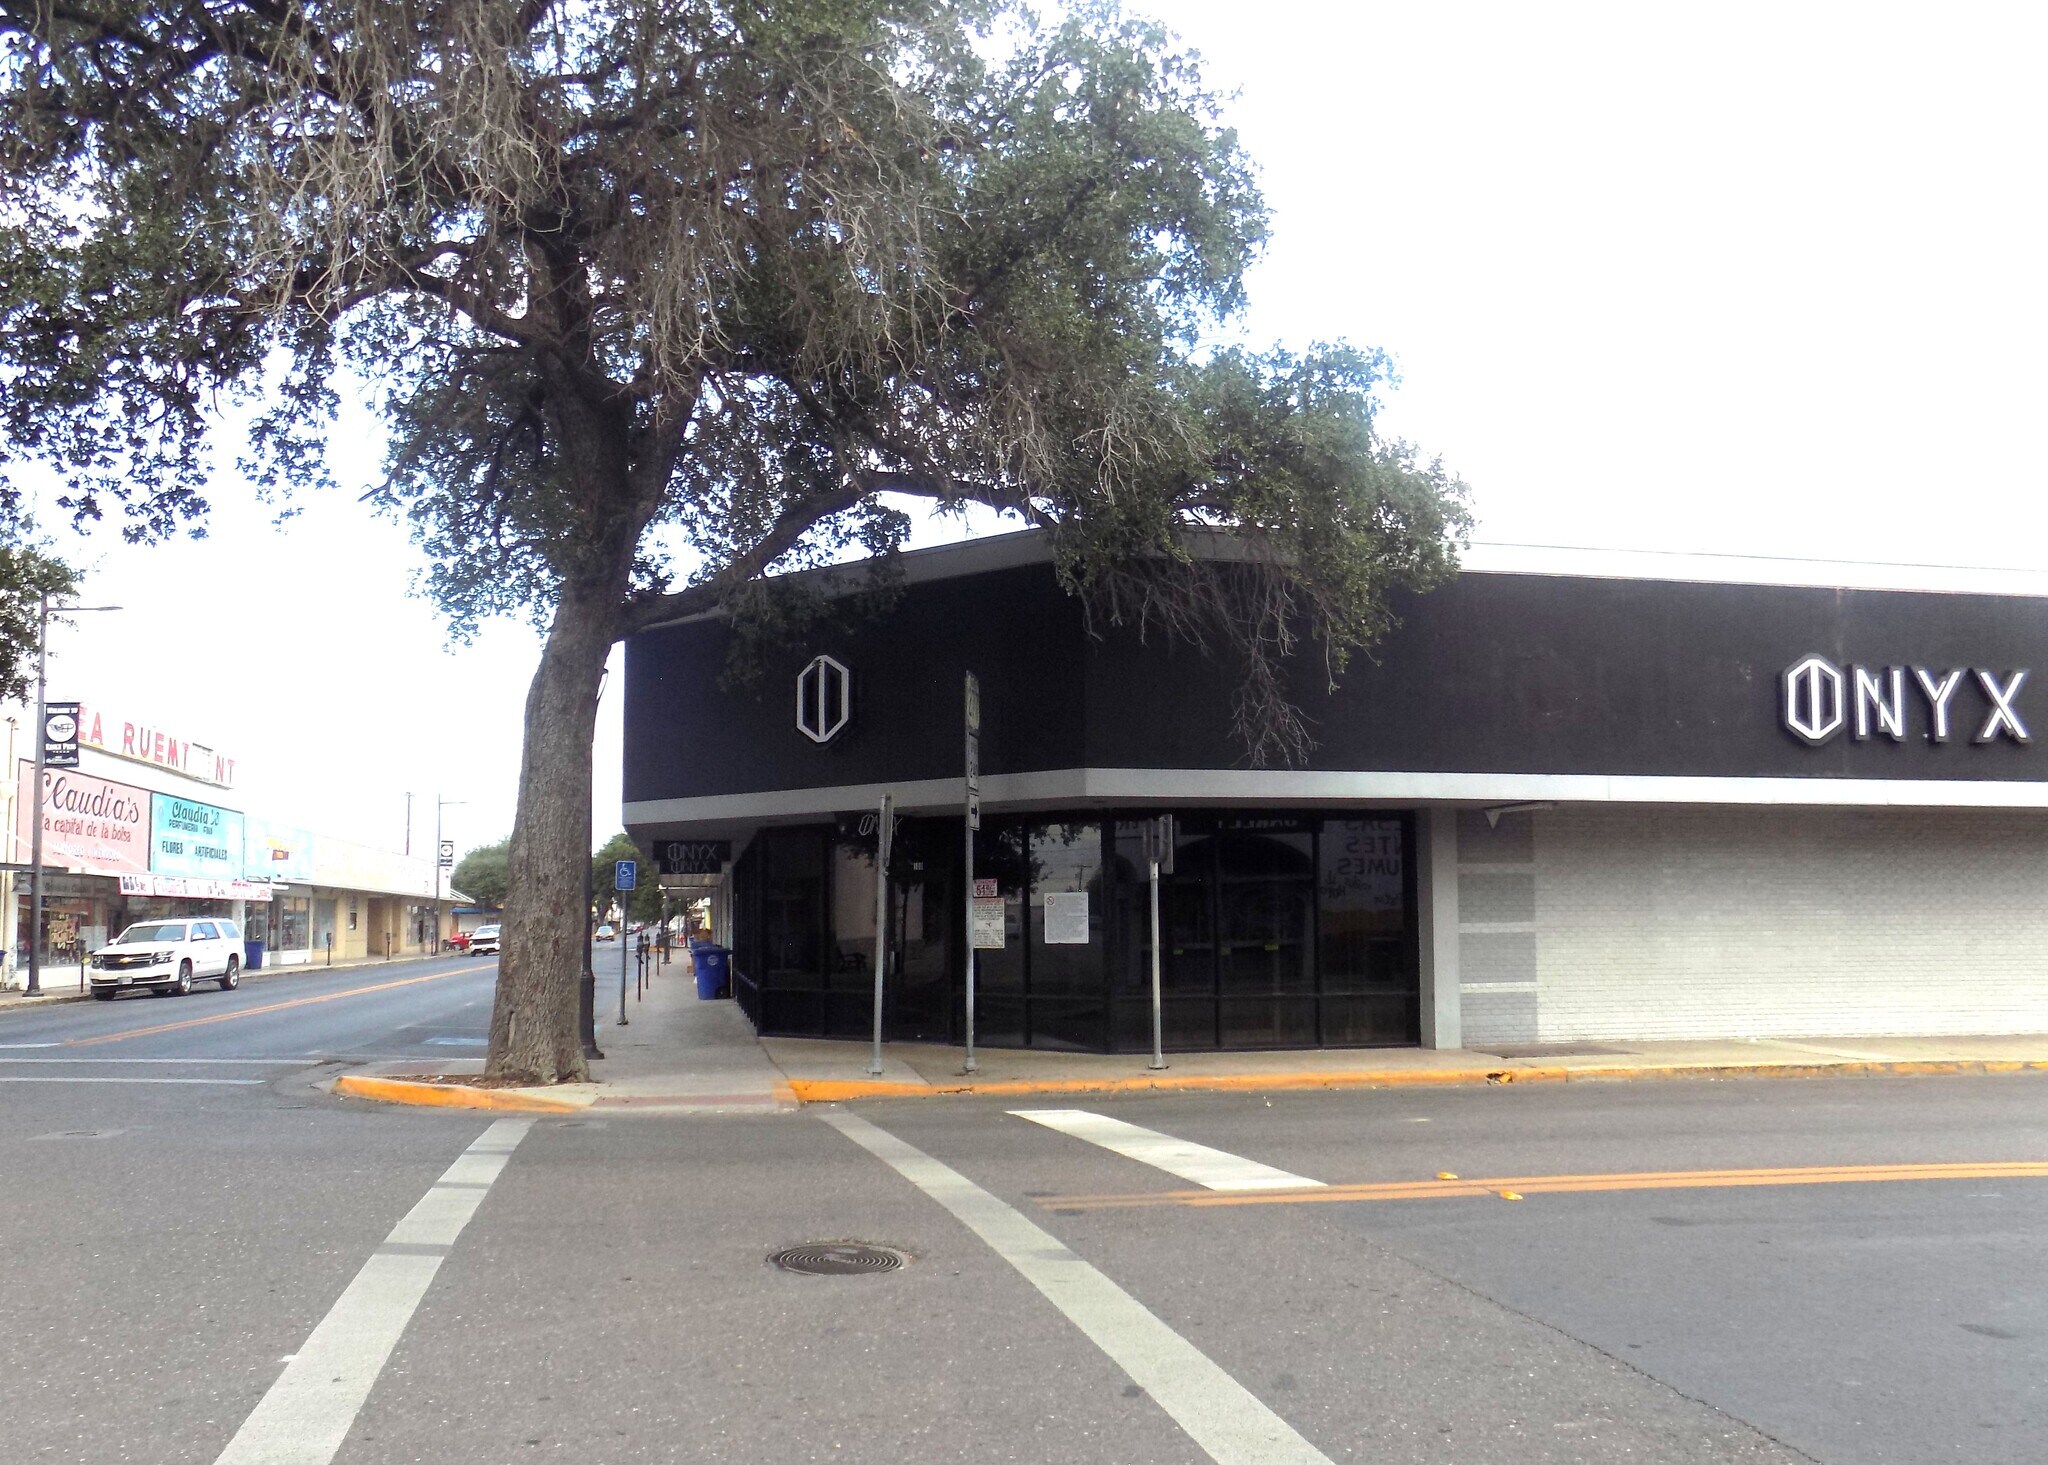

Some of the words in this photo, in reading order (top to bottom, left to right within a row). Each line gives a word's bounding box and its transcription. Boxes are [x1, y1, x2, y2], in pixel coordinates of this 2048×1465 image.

[1785, 656, 2030, 742] ONYX
[43, 773, 139, 824] Claudia's
[54, 817, 84, 842] capital
[86, 821, 98, 838] de
[101, 822, 109, 839] la
[111, 824, 132, 843] bolsa
[858, 814, 904, 836] ONX
[161, 841, 184, 855] FLORES
[667, 842, 717, 862] ONYX
